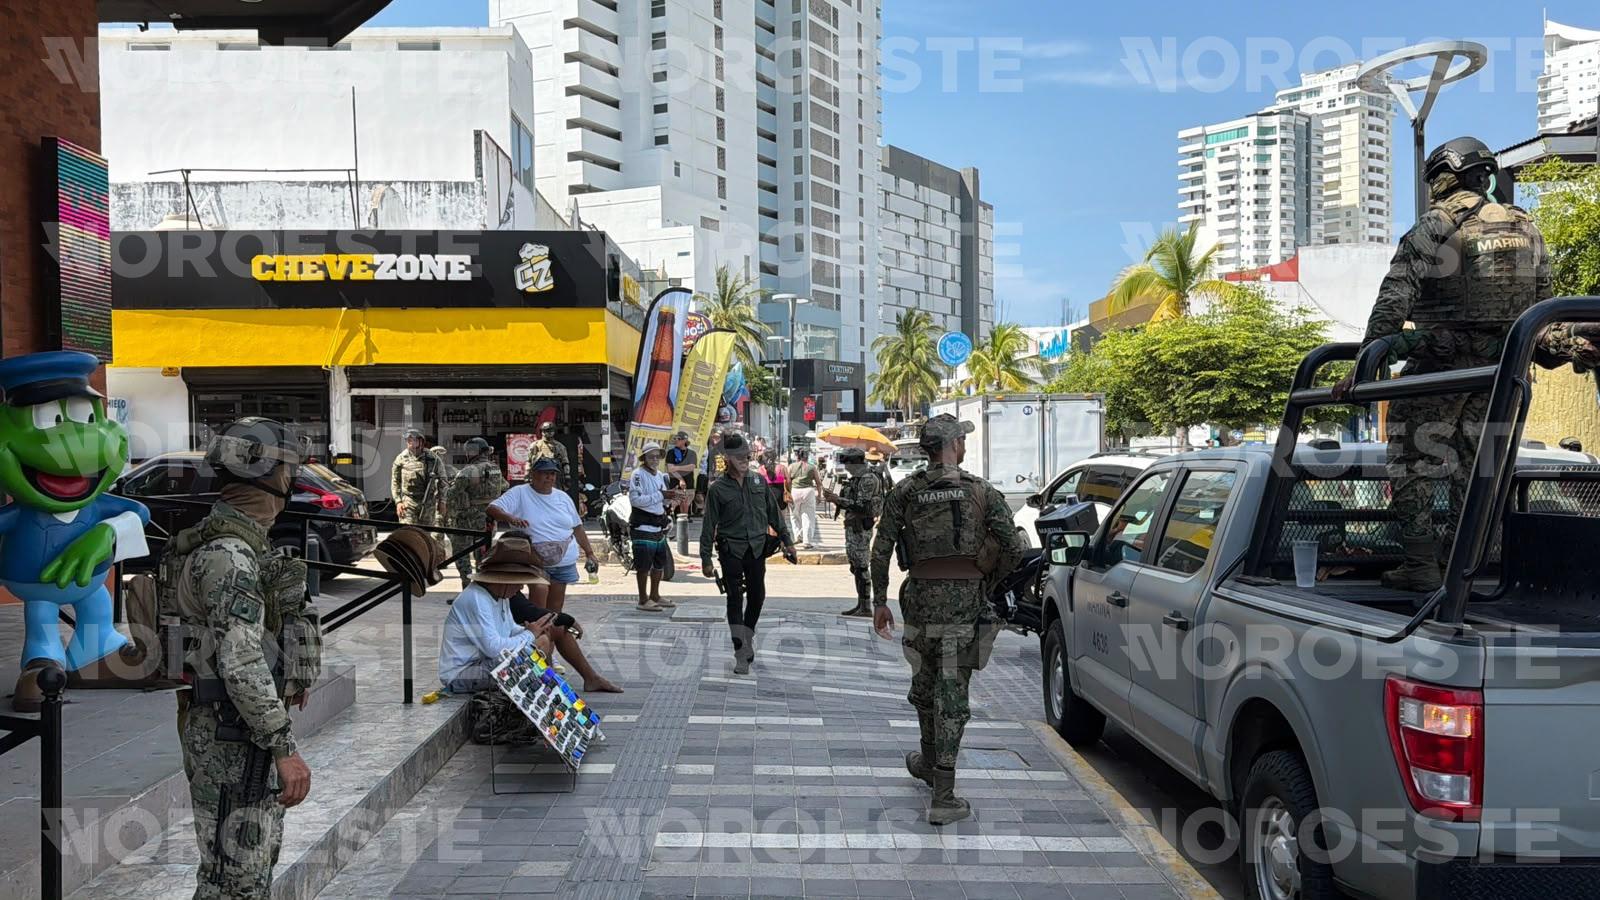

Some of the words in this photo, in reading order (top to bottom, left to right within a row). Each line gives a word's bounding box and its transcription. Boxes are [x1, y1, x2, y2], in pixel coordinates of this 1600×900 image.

[1477, 237, 1531, 252] MARINA
[251, 254, 472, 281] CHEVEZONE
[917, 489, 966, 503] MARINA
